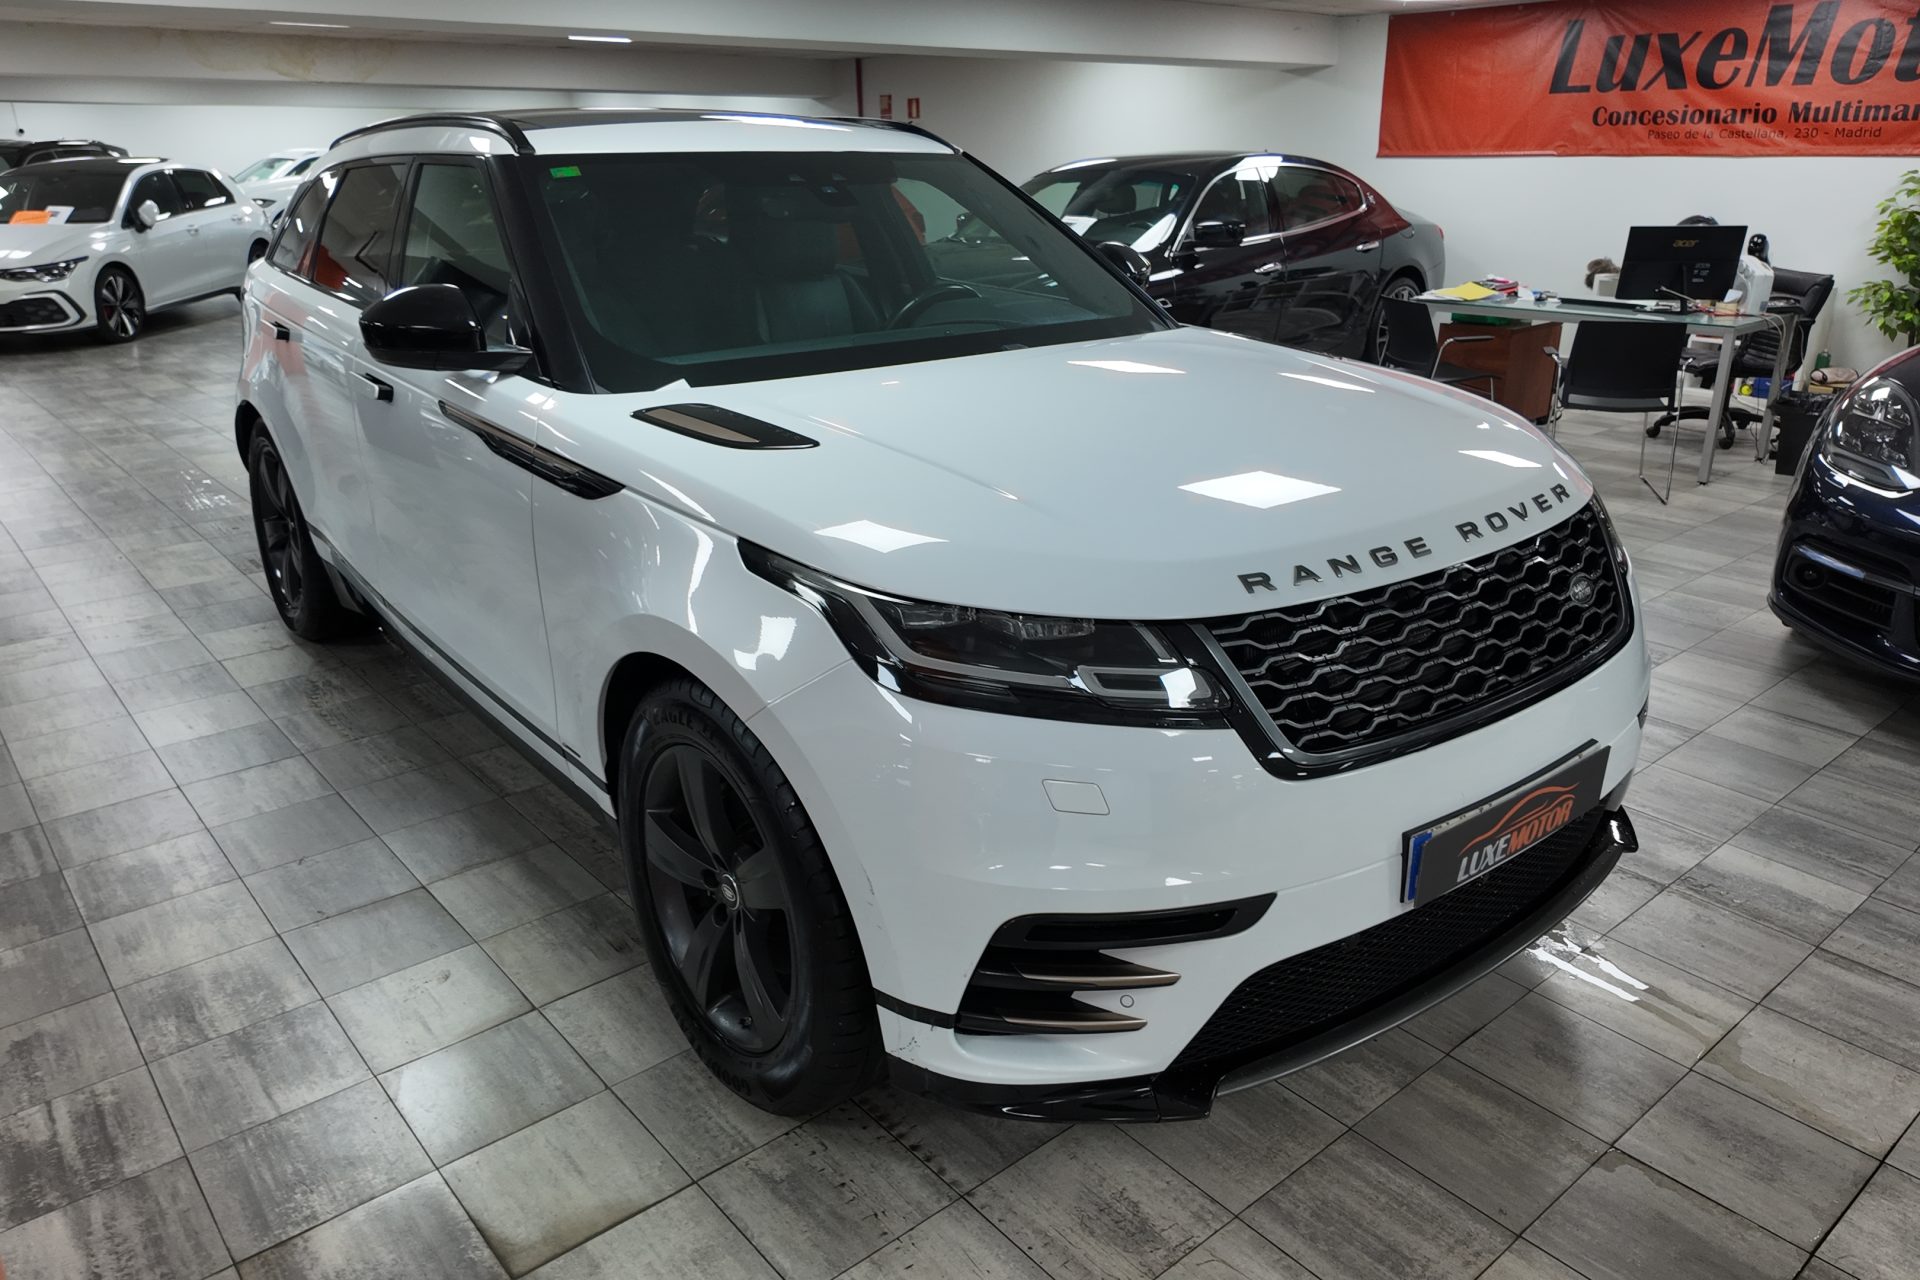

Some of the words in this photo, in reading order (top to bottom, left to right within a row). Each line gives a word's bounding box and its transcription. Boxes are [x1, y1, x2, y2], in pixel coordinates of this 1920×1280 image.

[1592, 102, 1777, 126] Concesionario
[1647, 129, 1680, 140] Paseo
[1684, 129, 1700, 139] de
[1704, 128, 1714, 139] la
[1719, 128, 1788, 140] Castellana,
[1793, 127, 1819, 138] 230
[1834, 125, 1882, 138] Madrid
[1237, 536, 1433, 595] RANGE
[1454, 482, 1571, 543] ROVER
[1456, 800, 1574, 883] LUXEMOTOR
